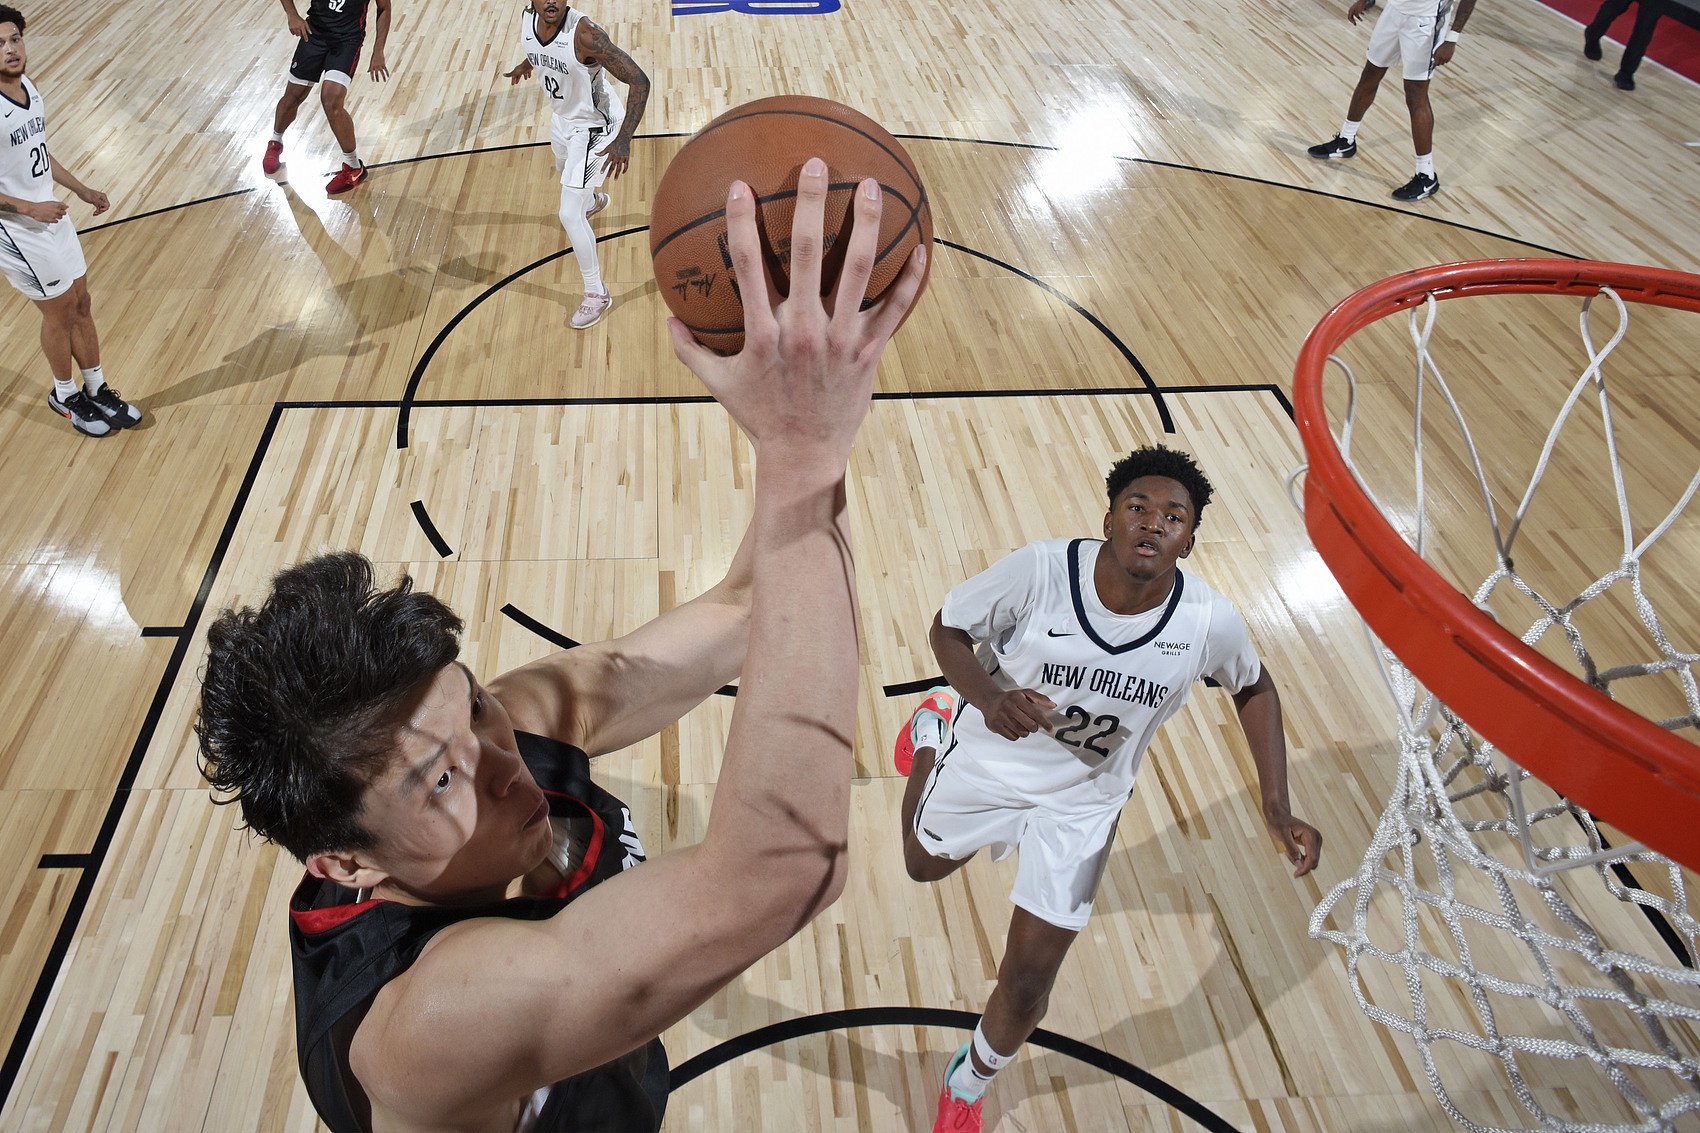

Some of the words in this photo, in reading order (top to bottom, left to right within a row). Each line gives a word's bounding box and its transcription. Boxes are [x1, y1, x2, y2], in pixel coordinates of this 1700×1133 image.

[540, 54, 569, 74] ORLEANS
[544, 75, 564, 99] 42
[10, 124, 28, 147] NEW
[30, 142, 49, 178] 20
[1154, 641, 1190, 650] NEWAGE
[1041, 663, 1087, 690] NEW
[1089, 668, 1169, 709] ORLEANS
[1055, 705, 1120, 758] 22
